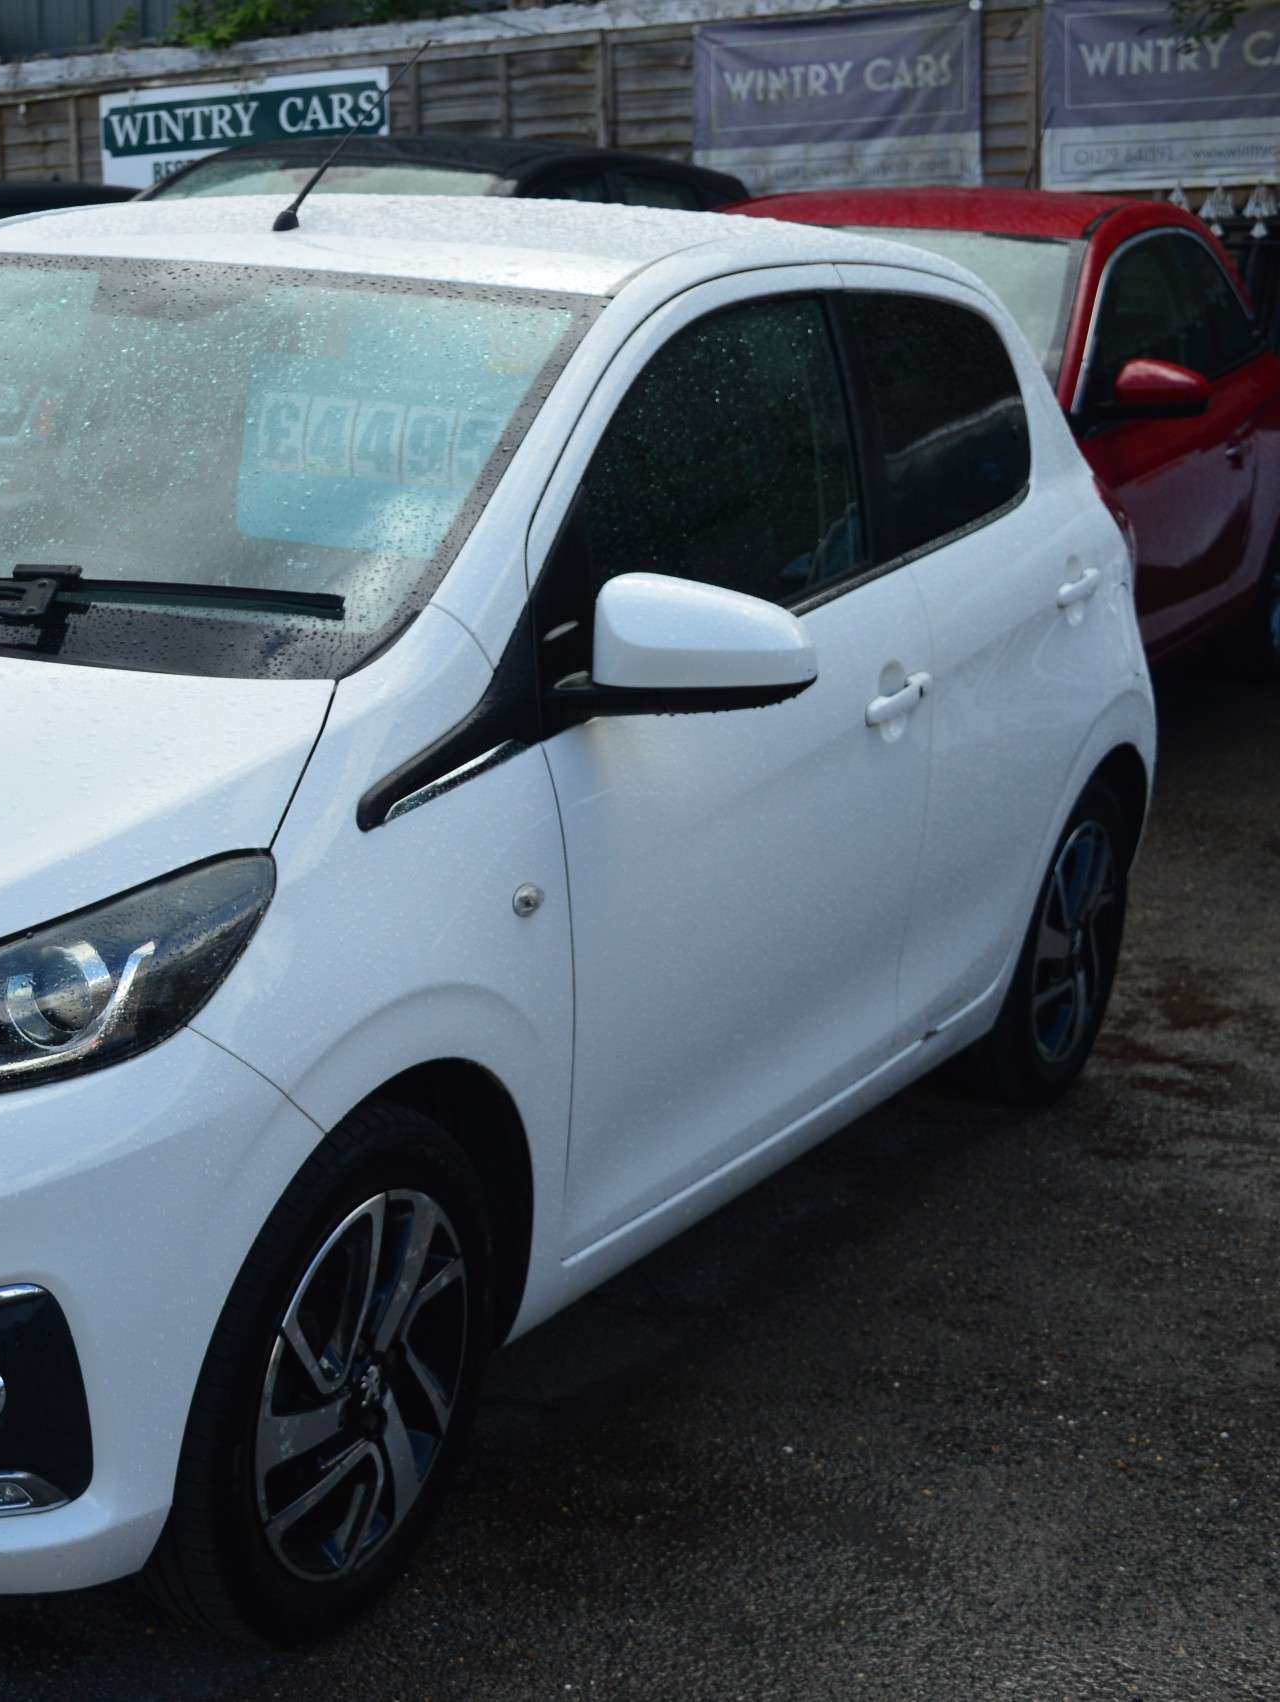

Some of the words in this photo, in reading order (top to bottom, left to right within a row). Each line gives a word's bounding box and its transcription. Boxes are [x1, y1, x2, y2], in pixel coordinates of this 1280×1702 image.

[723, 60, 854, 102] WINTRY
[863, 52, 952, 93] CARS
[1077, 33, 1231, 79] WINTRY
[109, 101, 259, 149] WINTRY
[278, 89, 381, 134] CARS
